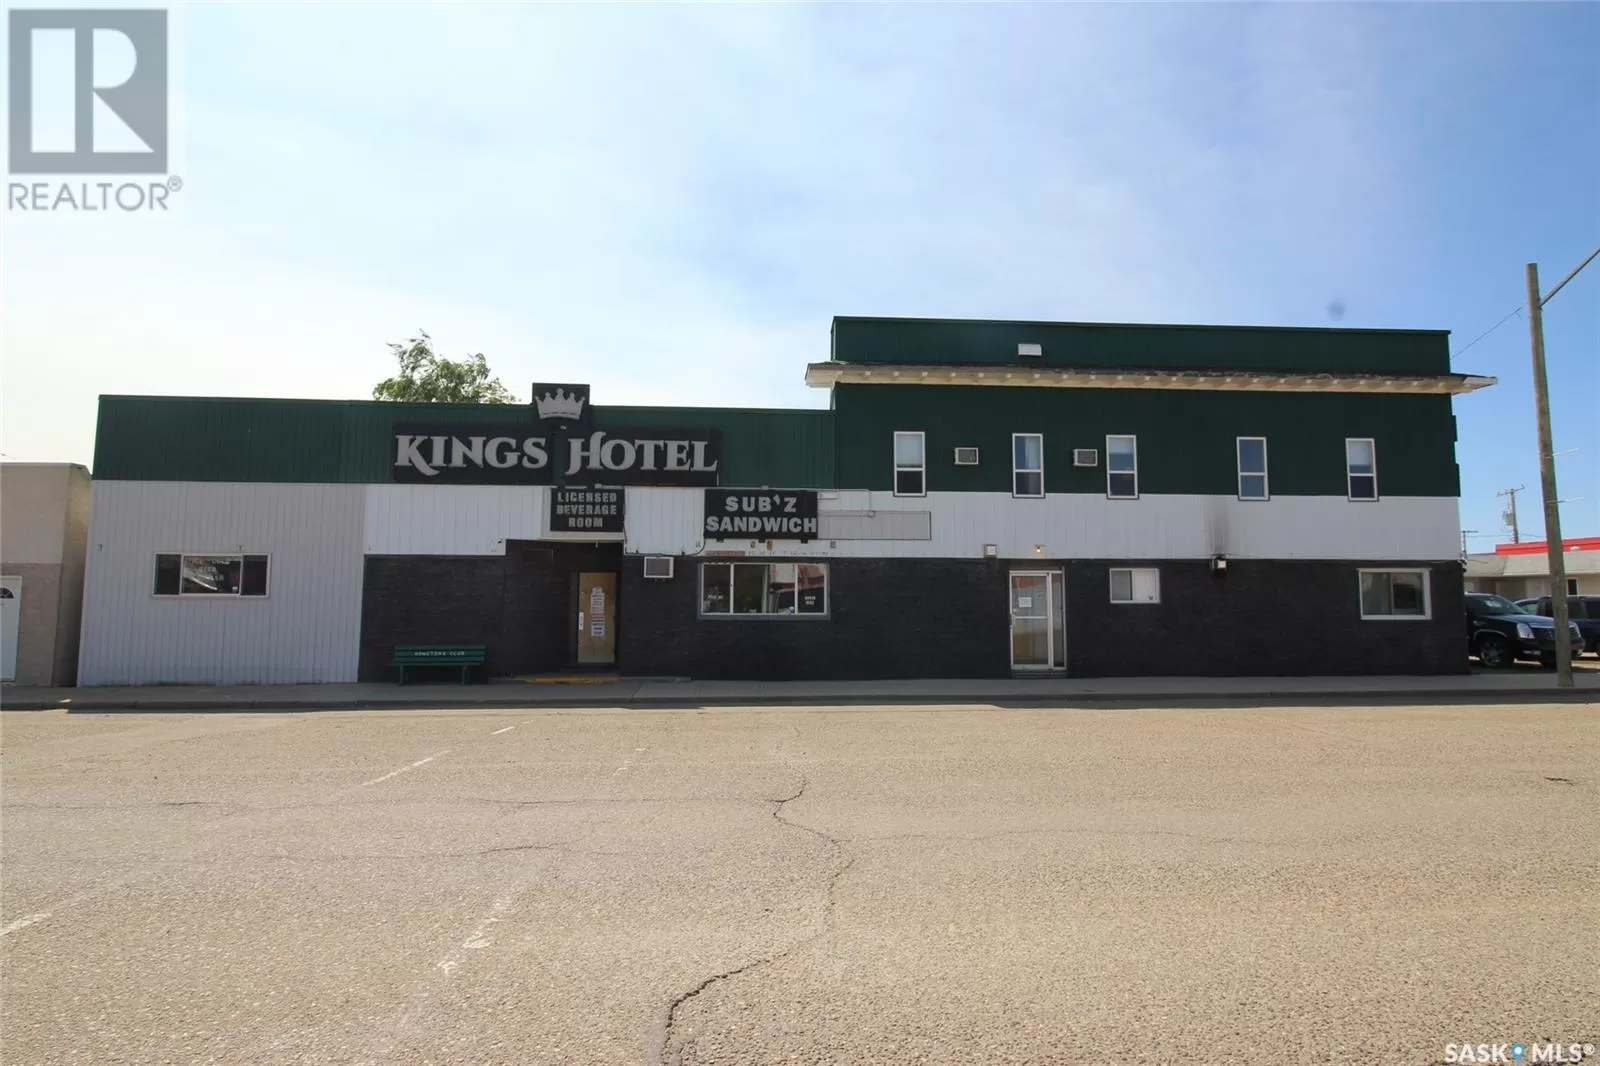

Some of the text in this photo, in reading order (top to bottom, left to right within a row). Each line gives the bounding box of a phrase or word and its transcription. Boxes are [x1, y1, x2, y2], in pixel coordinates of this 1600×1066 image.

[394, 431, 718, 476] KINGS HOTEL
[557, 492, 617, 503] LICENSED
[556, 504, 617, 515] BEVERAGE
[568, 517, 603, 528] ROOM
[705, 516, 817, 533] SANDWICH
